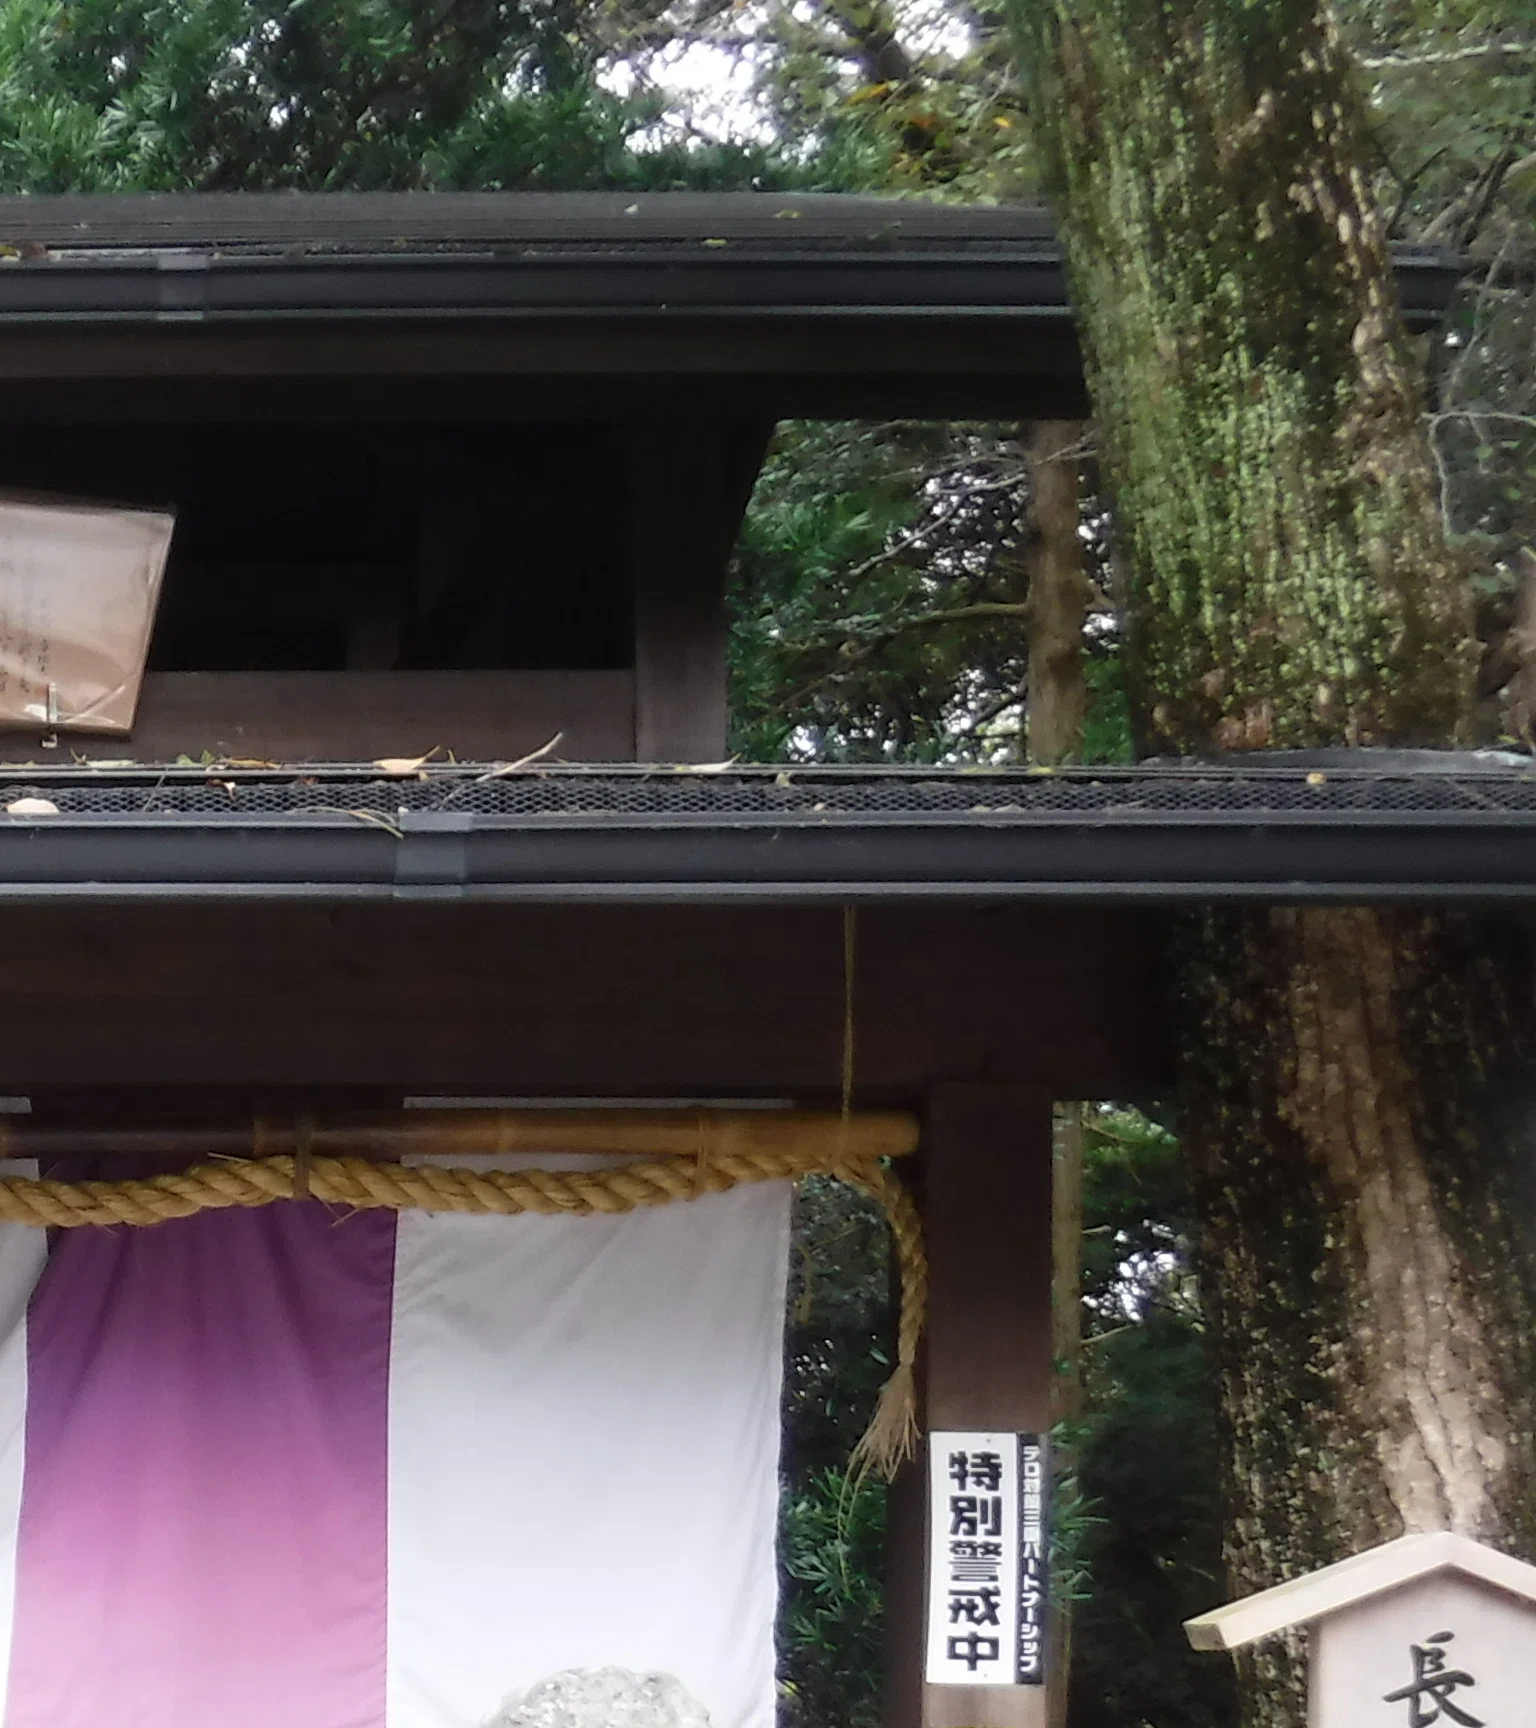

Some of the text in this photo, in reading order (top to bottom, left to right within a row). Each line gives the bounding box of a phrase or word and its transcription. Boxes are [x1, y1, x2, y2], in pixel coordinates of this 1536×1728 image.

[947, 1450, 1004, 1672] 特別警戒中
